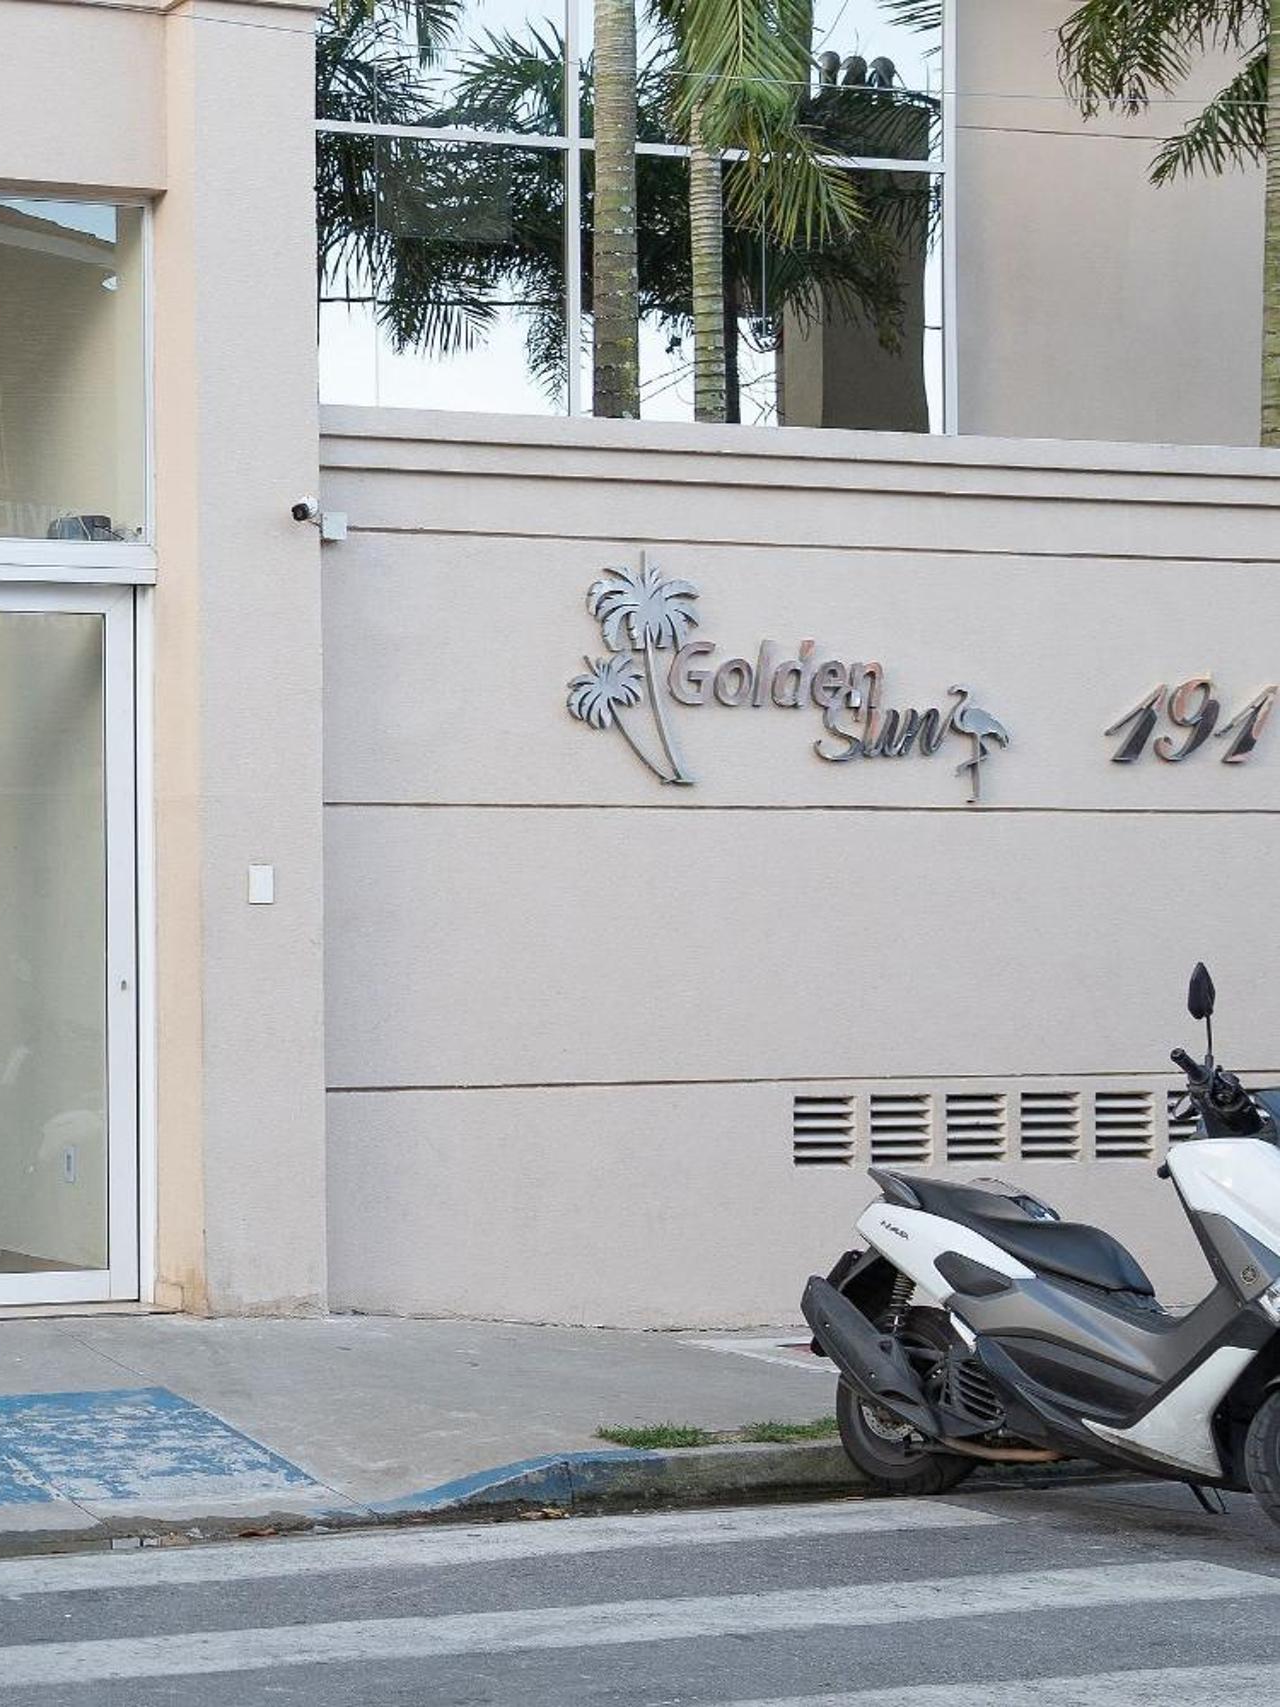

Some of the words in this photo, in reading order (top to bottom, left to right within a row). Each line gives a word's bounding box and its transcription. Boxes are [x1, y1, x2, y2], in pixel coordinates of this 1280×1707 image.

[668, 638, 883, 708] Golden
[813, 690, 957, 761] Sun
[1104, 678, 1280, 764] 191
